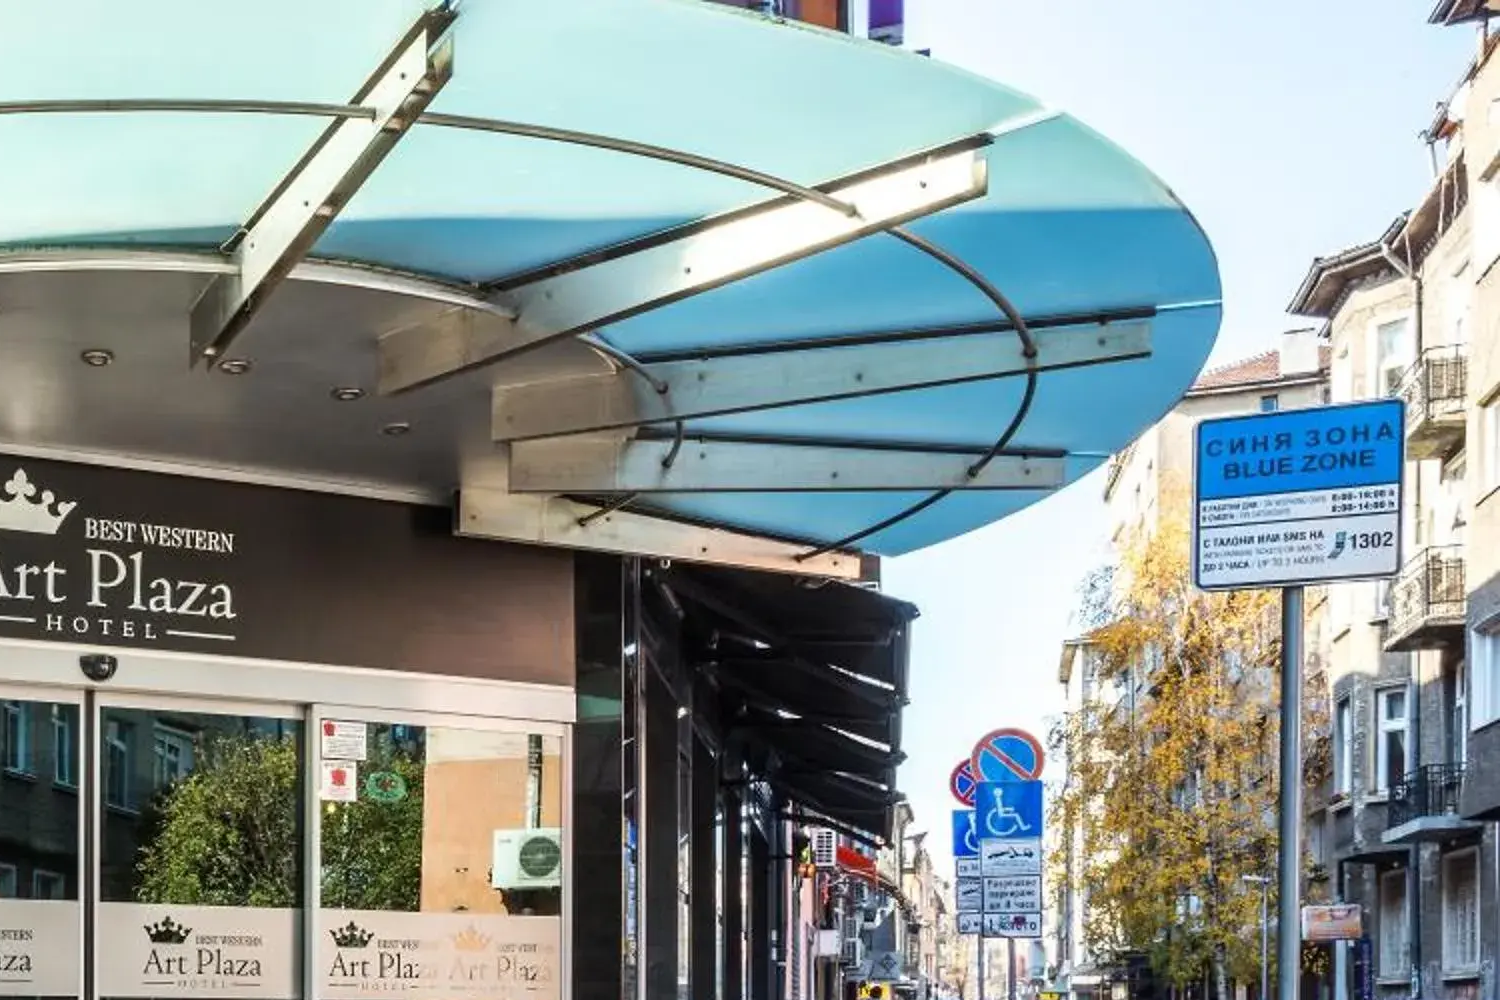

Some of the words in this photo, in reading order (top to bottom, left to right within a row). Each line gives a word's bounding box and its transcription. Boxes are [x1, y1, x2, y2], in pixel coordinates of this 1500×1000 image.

[1205, 433, 1293, 458] СИНЯ
[1306, 421, 1396, 448] ЗОНА
[1223, 456, 1294, 480] BLUE
[1300, 449, 1376, 473] ZONE
[85, 517, 137, 543] BEST
[140, 524, 235, 553] WESTERN
[1350, 531, 1394, 550] 1302
[86, 549, 237, 620] Plaza
[46, 613, 158, 640] HOTEL
[143, 948, 189, 976] Art
[195, 947, 263, 977] Plaza
[328, 951, 371, 978] Art
